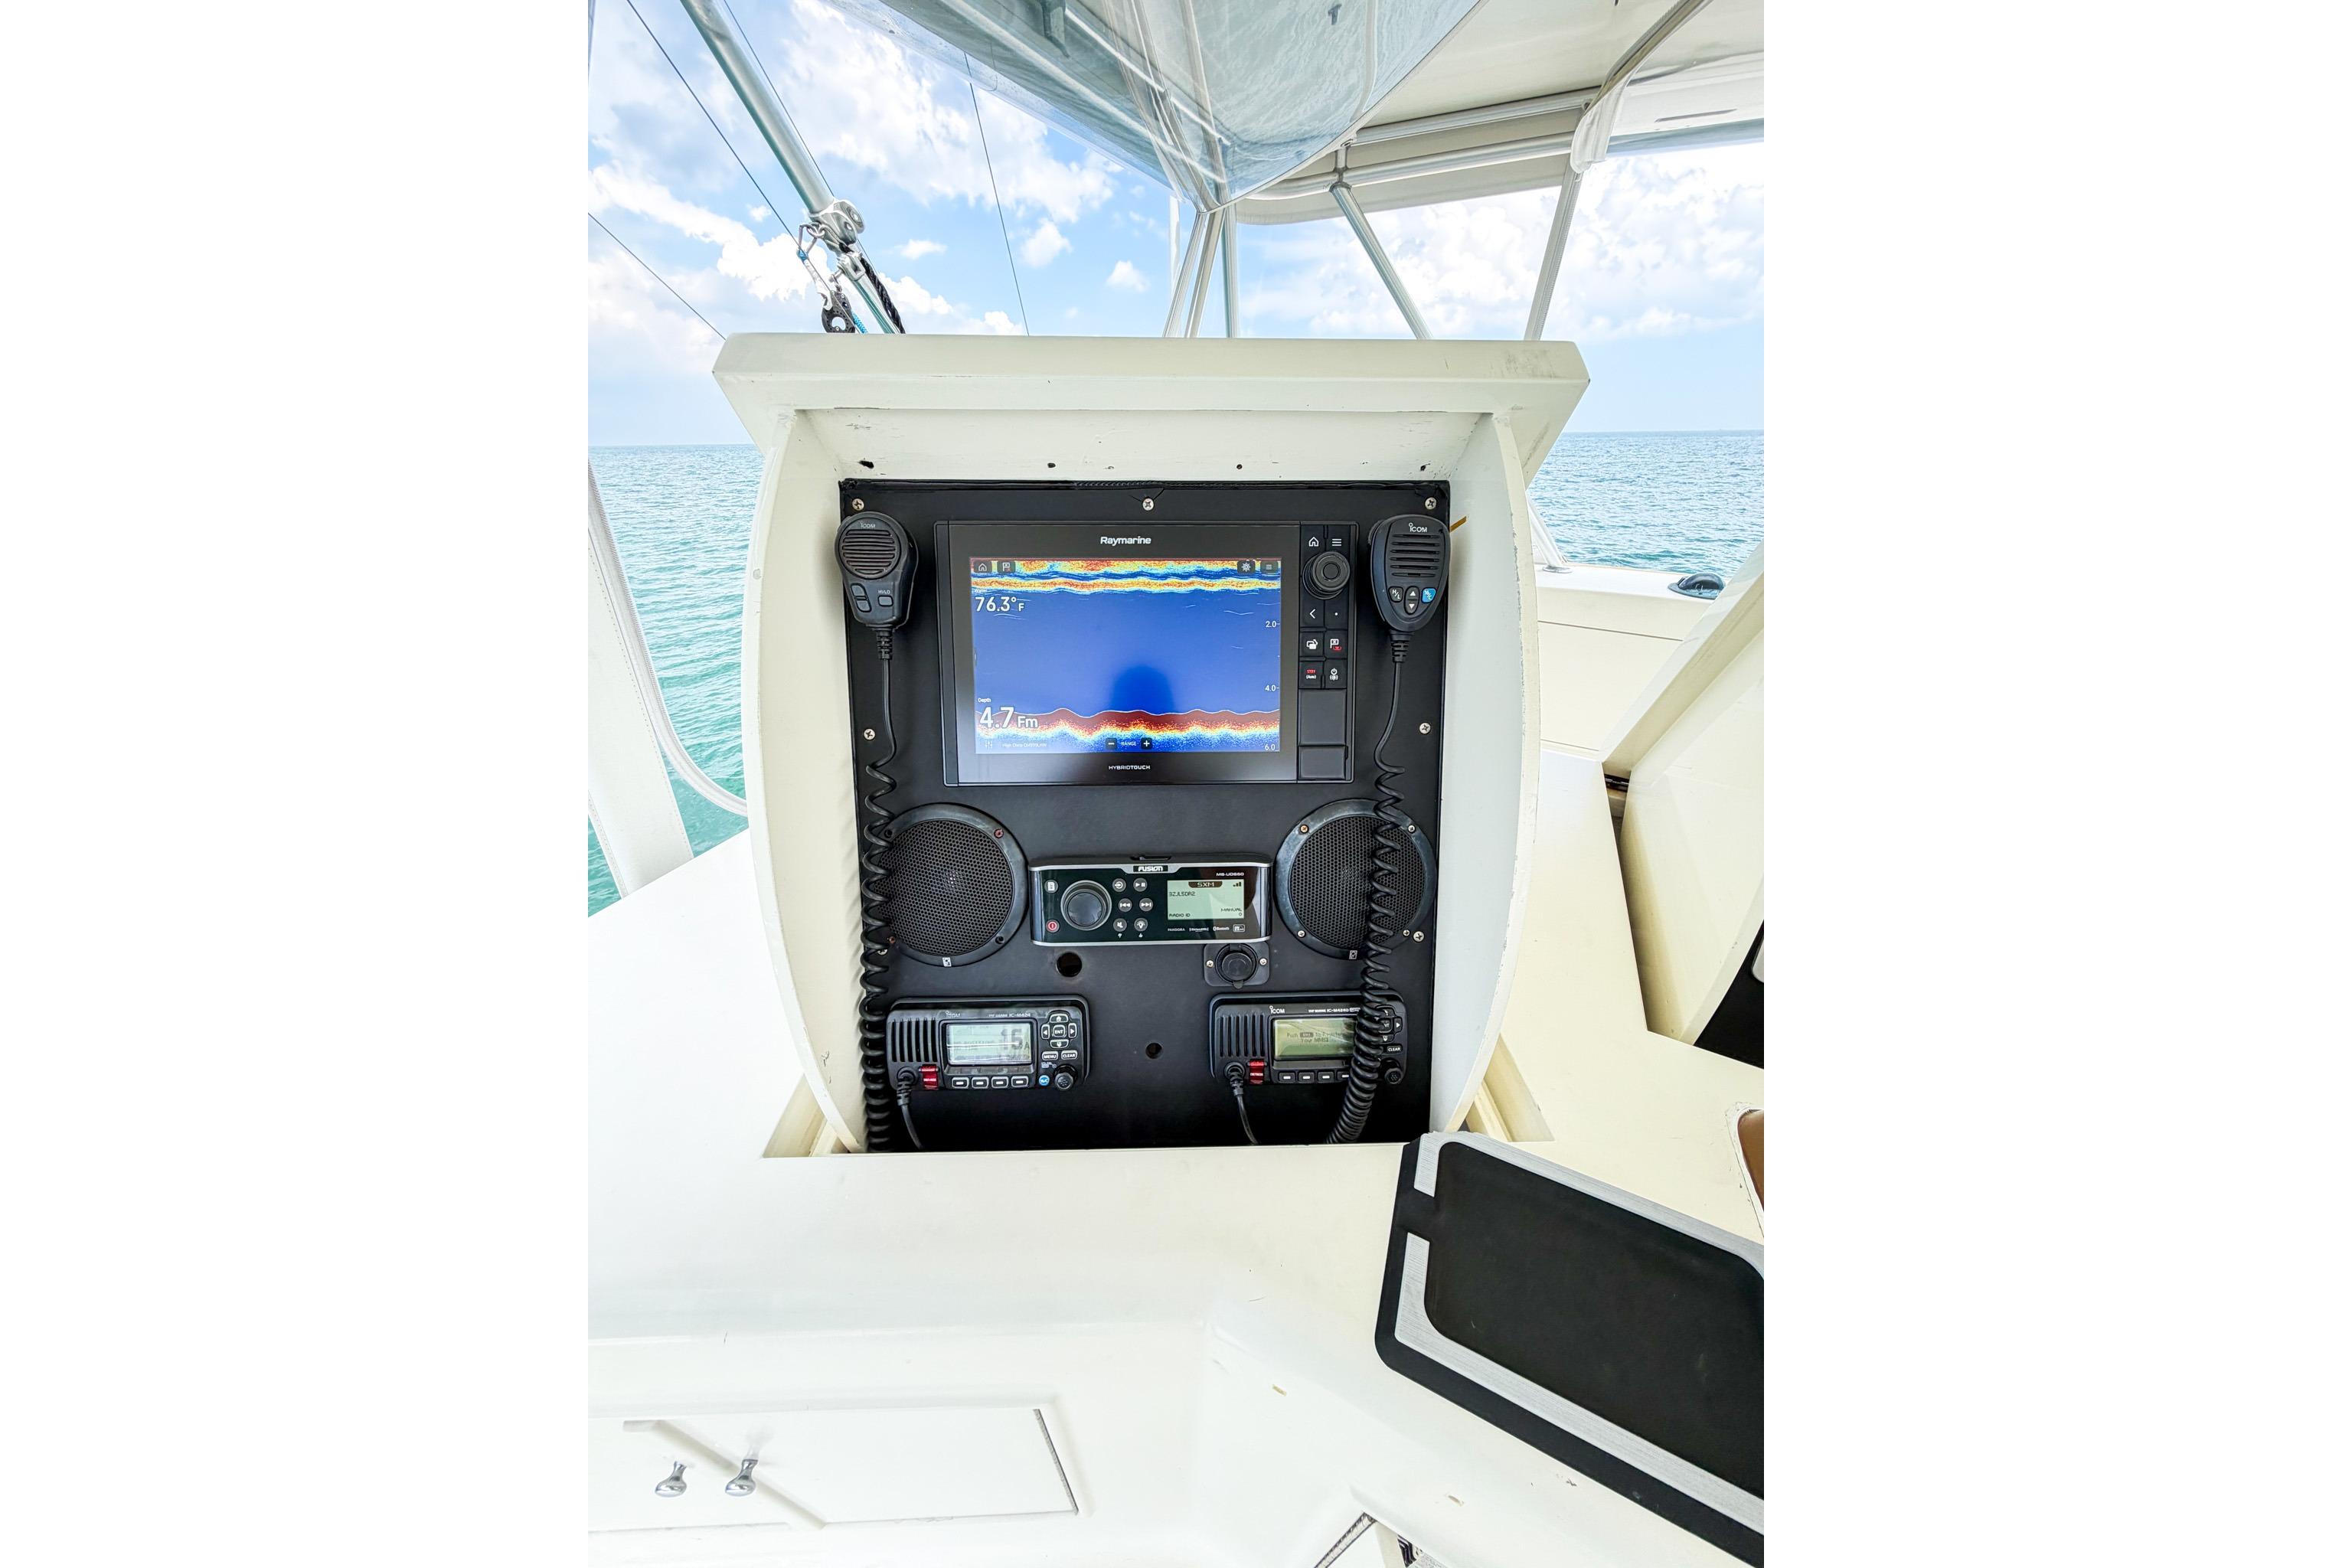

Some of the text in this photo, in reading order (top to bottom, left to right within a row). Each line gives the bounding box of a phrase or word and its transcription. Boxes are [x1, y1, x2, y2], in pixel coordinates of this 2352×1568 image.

[1100, 536, 1152, 547] Raymarine
[1018, 603, 1024, 612] F
[979, 707, 1038, 728] 4.7 Fm
